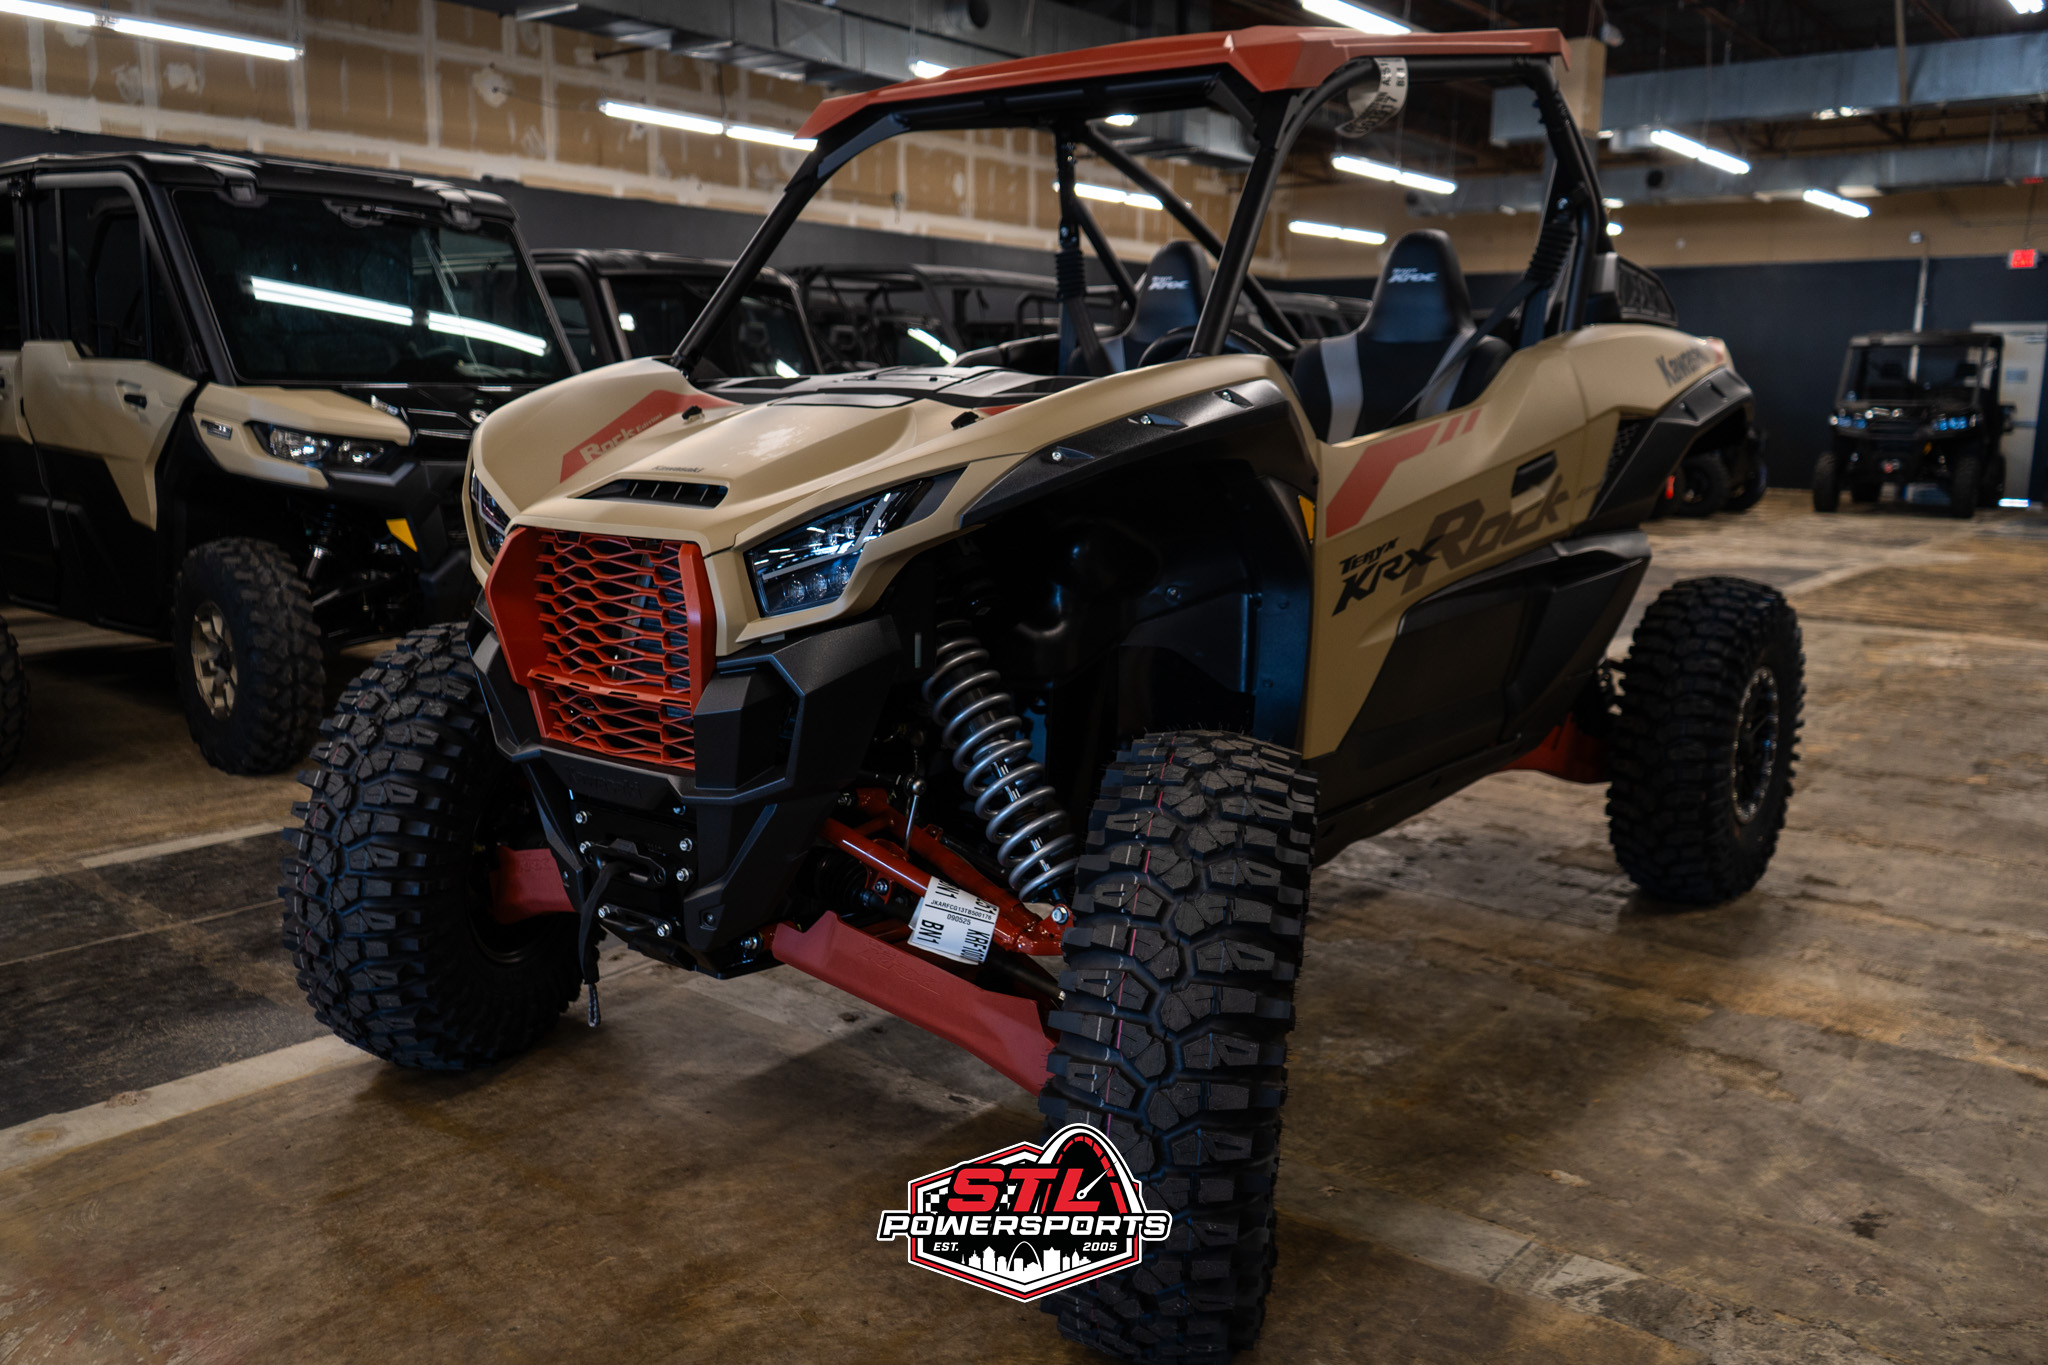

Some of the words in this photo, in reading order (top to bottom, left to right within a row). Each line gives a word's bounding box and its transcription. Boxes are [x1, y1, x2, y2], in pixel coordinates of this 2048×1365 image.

[579, 427, 636, 464] Rock
[1401, 473, 1570, 596] Rock
[1331, 534, 1444, 617] KRX
[917, 919, 945, 944] BN1
